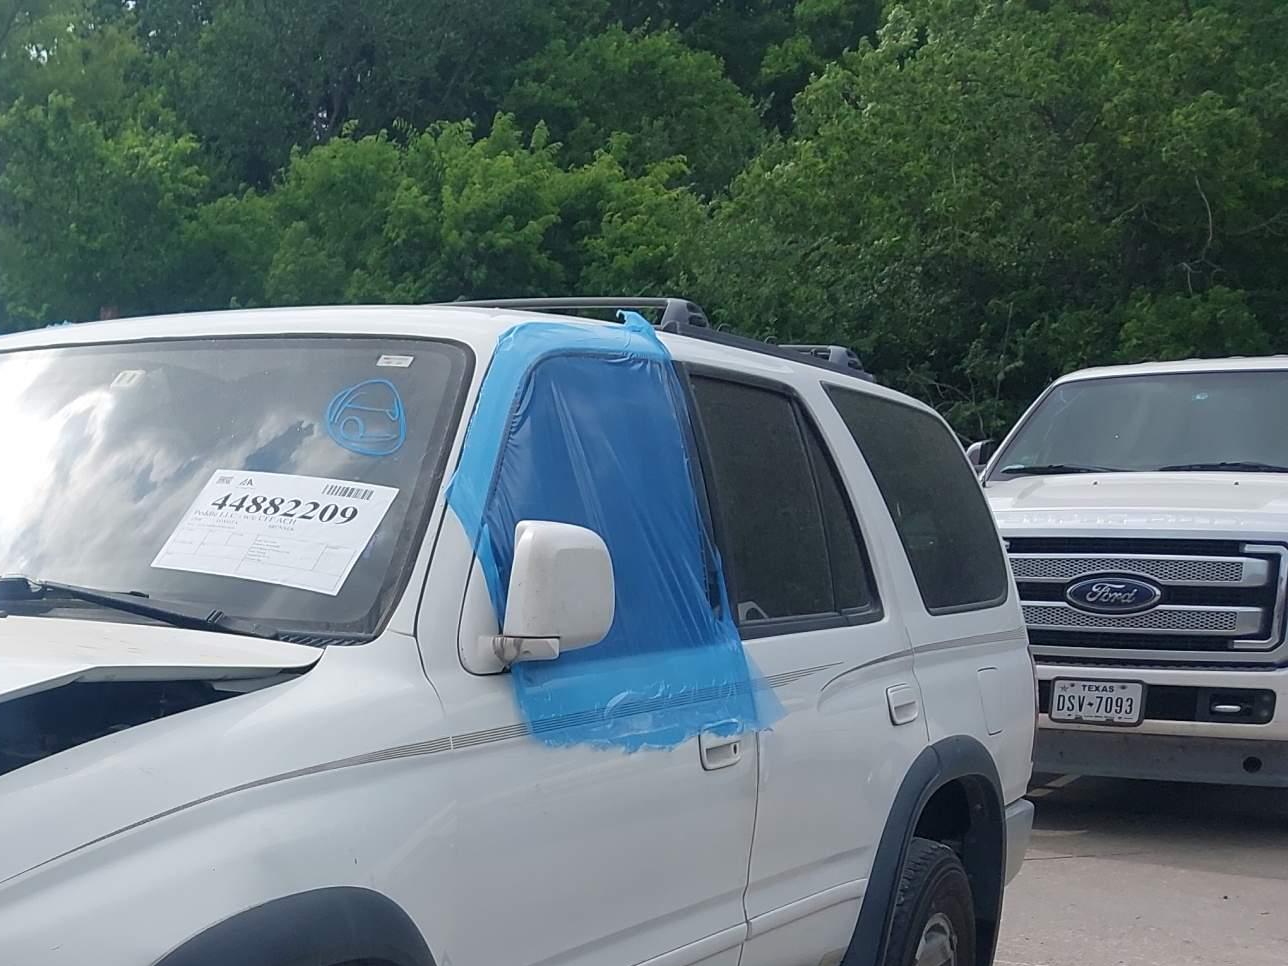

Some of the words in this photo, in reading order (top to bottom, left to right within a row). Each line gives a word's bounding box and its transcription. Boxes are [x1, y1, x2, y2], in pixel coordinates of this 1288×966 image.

[211, 492, 359, 525] 44882209
[1086, 582, 1138, 604] Ford
[1081, 684, 1115, 693] TEXAS
